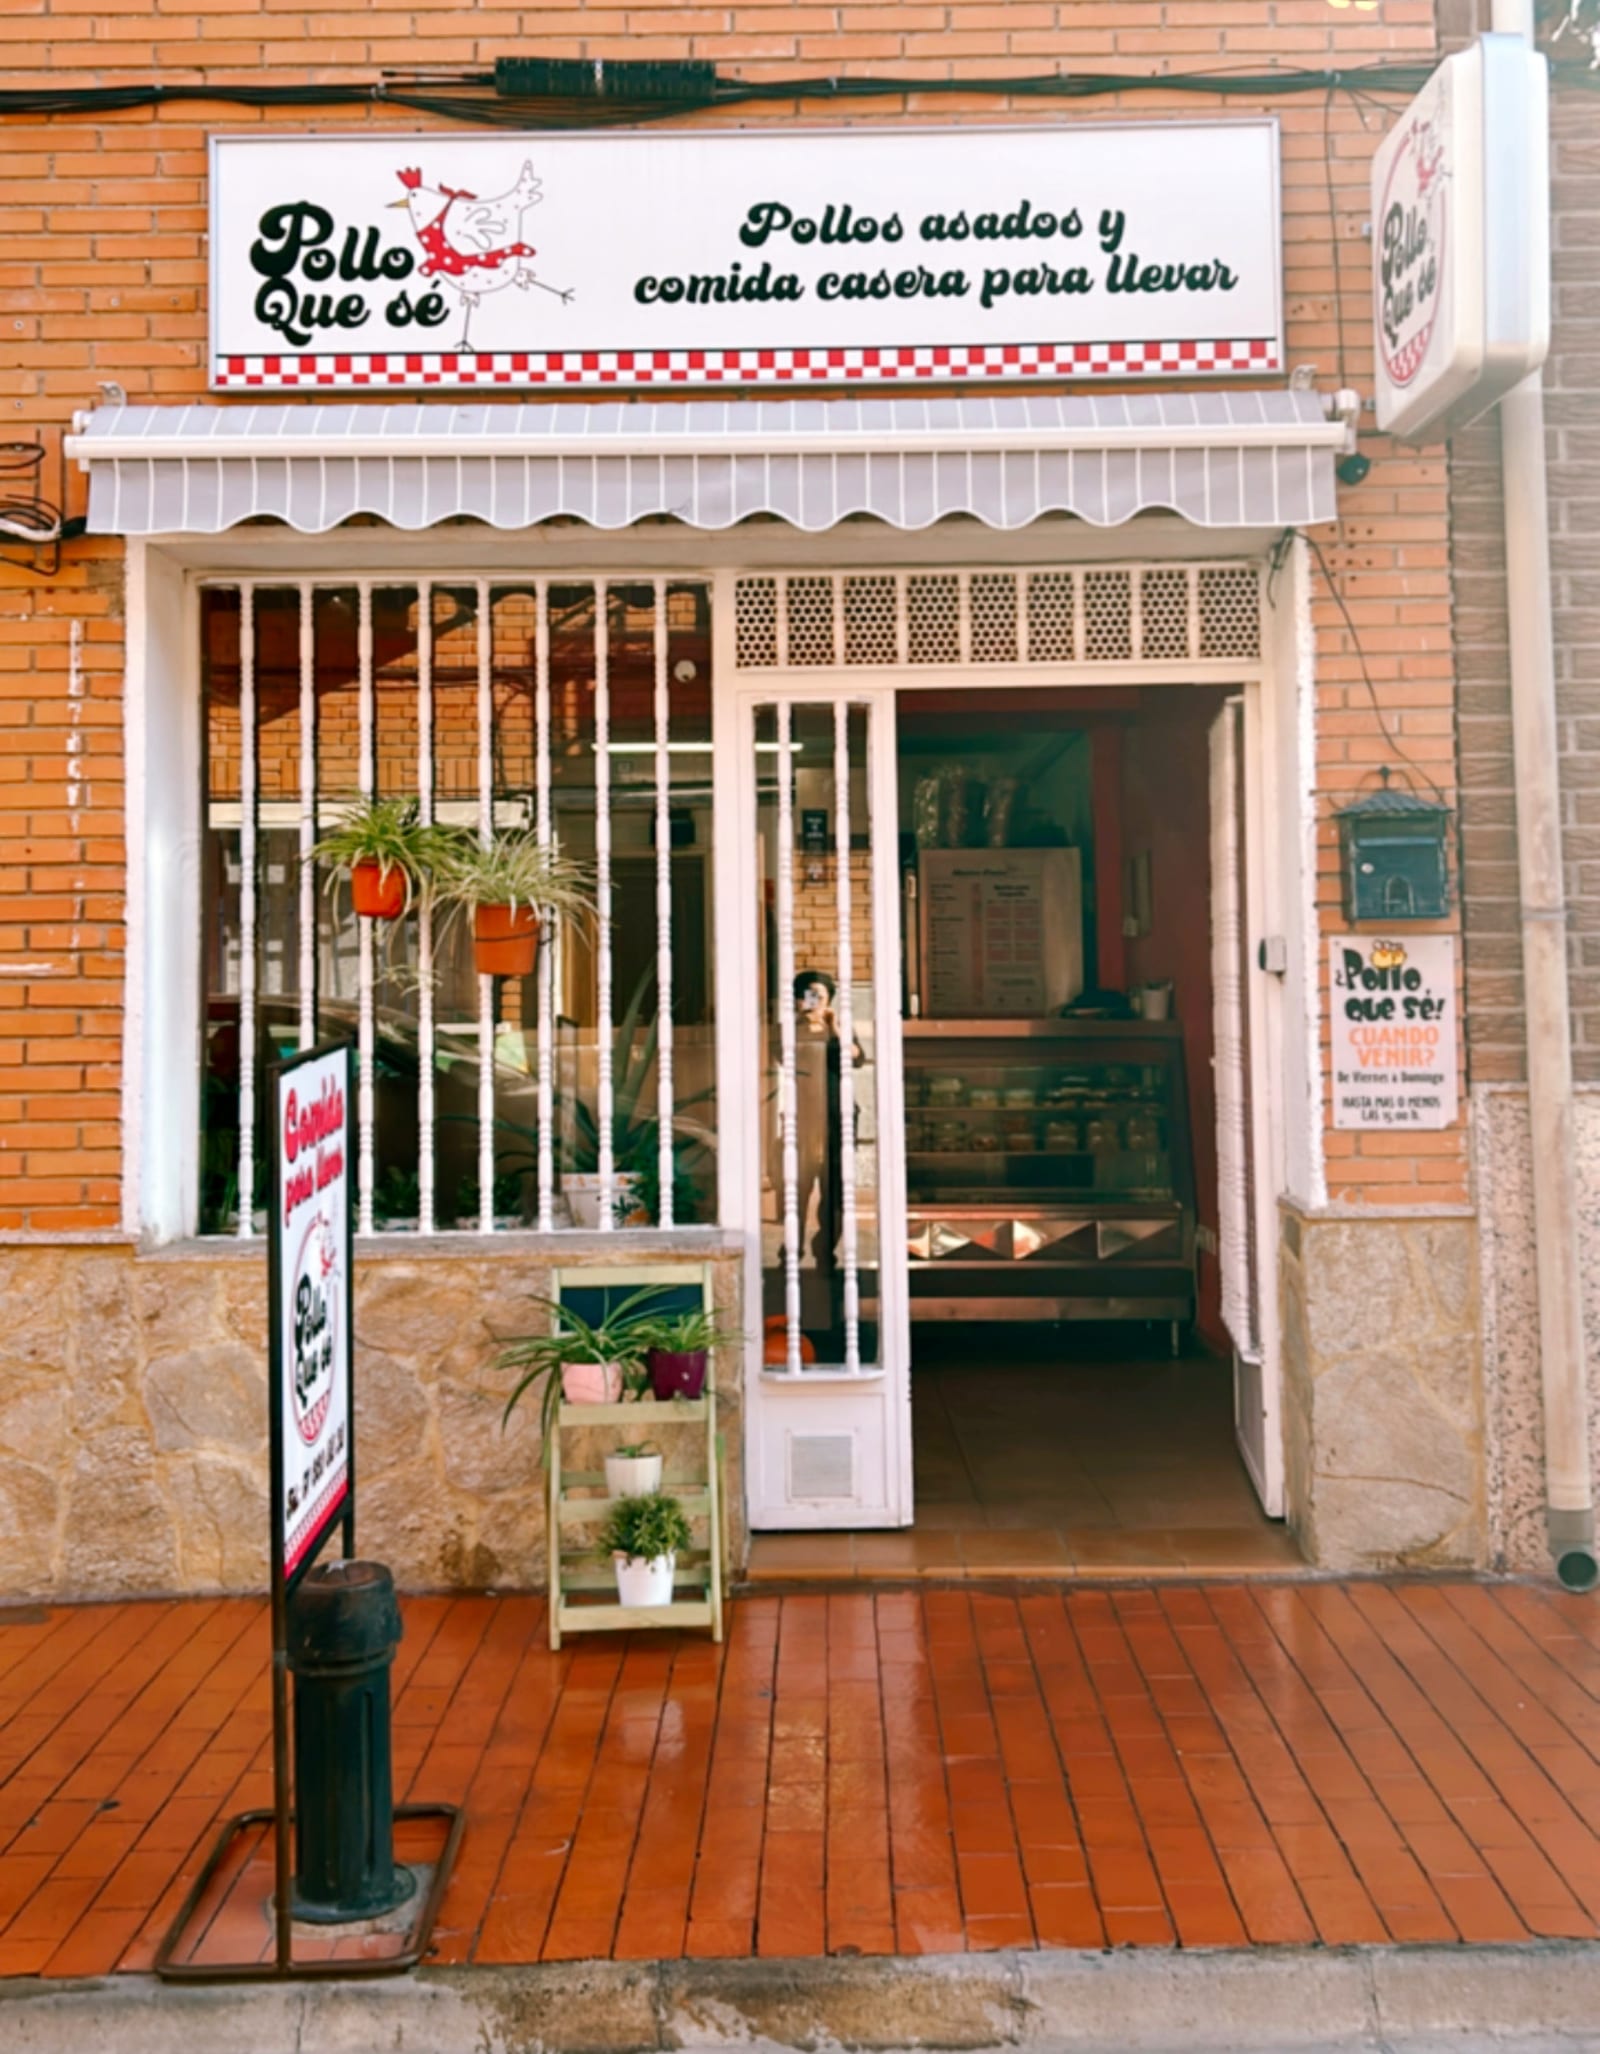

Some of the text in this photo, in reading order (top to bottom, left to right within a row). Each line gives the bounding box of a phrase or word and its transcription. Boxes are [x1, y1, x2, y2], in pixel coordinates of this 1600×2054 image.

[250, 201, 414, 281] Pollo
[738, 200, 1125, 253] Pollos asados y
[634, 254, 1238, 308] comida casera para llevar
[254, 276, 450, 347] Que sé
[1348, 1027, 1440, 1046] CUANDO
[1356, 1048, 1436, 1068] VENIR?
